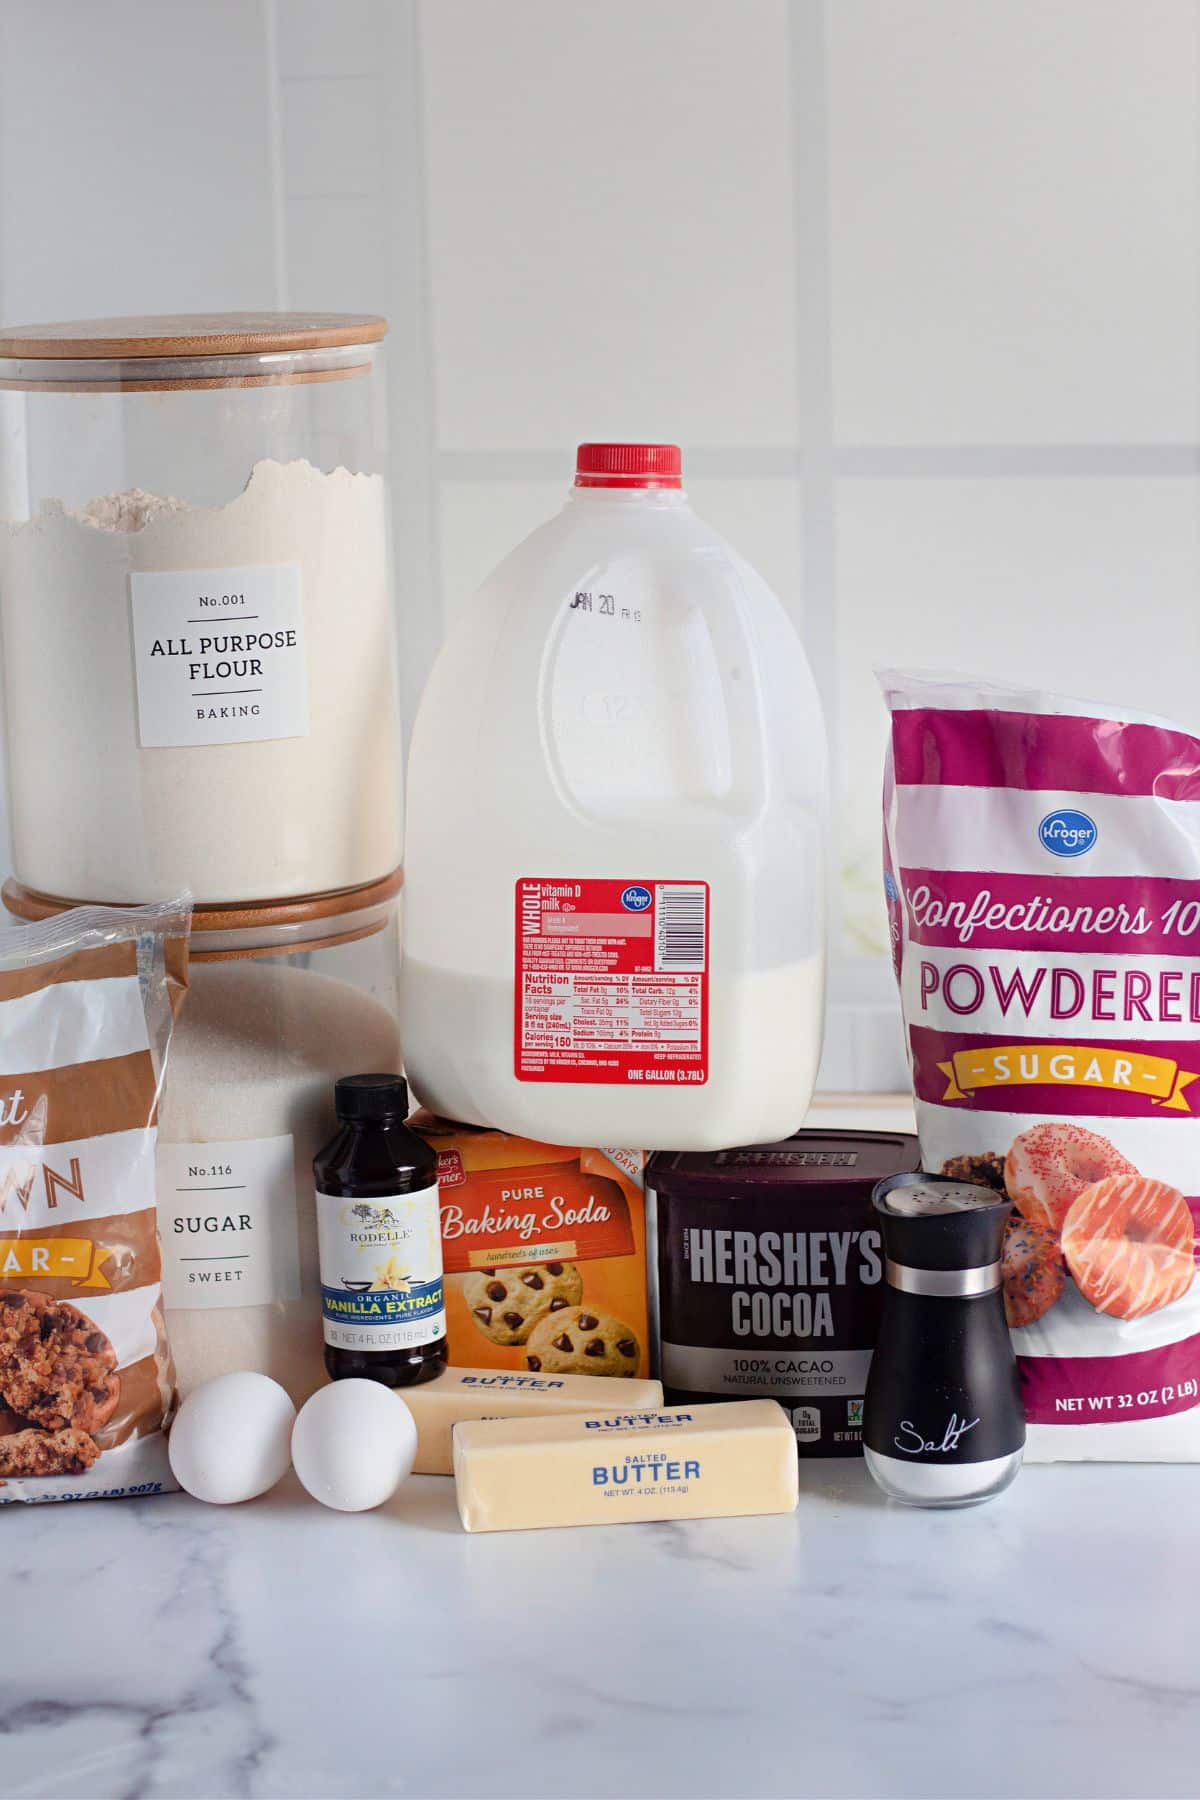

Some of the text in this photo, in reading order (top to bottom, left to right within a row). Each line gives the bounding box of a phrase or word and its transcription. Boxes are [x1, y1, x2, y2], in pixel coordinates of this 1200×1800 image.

[199, 594, 246, 607] No.001
[599, 594, 615, 616] 20
[150, 630, 297, 656] ALL PURPOSE
[188, 659, 264, 680] FLOUR
[196, 705, 260, 720] BAKING
[1043, 819, 1094, 848] Kroger
[542, 884, 581, 898] vitamin D
[542, 898, 560, 910] milk
[626, 890, 648, 908] Kroger
[522, 883, 540, 936] WHOLE
[907, 886, 1152, 942] Confectioners
[525, 974, 569, 984] Nutrition
[525, 984, 552, 994] Facts
[525, 1032, 553, 1040] Calories
[555, 1037, 571, 1047] 150
[628, 1069, 643, 1080] ONE
[645, 1070, 675, 1080] GALLON
[188, 1164, 232, 1176] No.116
[615, 1152, 638, 1174] DAYS
[438, 1172, 461, 1184] rner
[502, 1186, 544, 1200] PURE
[174, 1214, 253, 1234] SUGAR
[440, 1196, 611, 1240] Baking Soda
[350, 1230, 410, 1242] RODELLE
[688, 1228, 882, 1286] HERSHEY'S
[188, 1270, 243, 1283] SWEET
[326, 1289, 442, 1313] VANILLA EXTRACT
[357, 1293, 413, 1302] ORGANIC
[732, 1291, 835, 1338] COCOA
[734, 1360, 834, 1373] 100% CACAO
[461, 1377, 564, 1388] BUTTER
[723, 1375, 847, 1386] NATURAL UNSWEETENED
[1055, 1378, 1198, 1411] NET WT 32 OZ (2 LB)
[584, 1414, 692, 1428] BUTTER
[894, 1412, 980, 1453] Salt
[625, 1454, 667, 1463] SALTED
[592, 1461, 700, 1486] BUTTER
